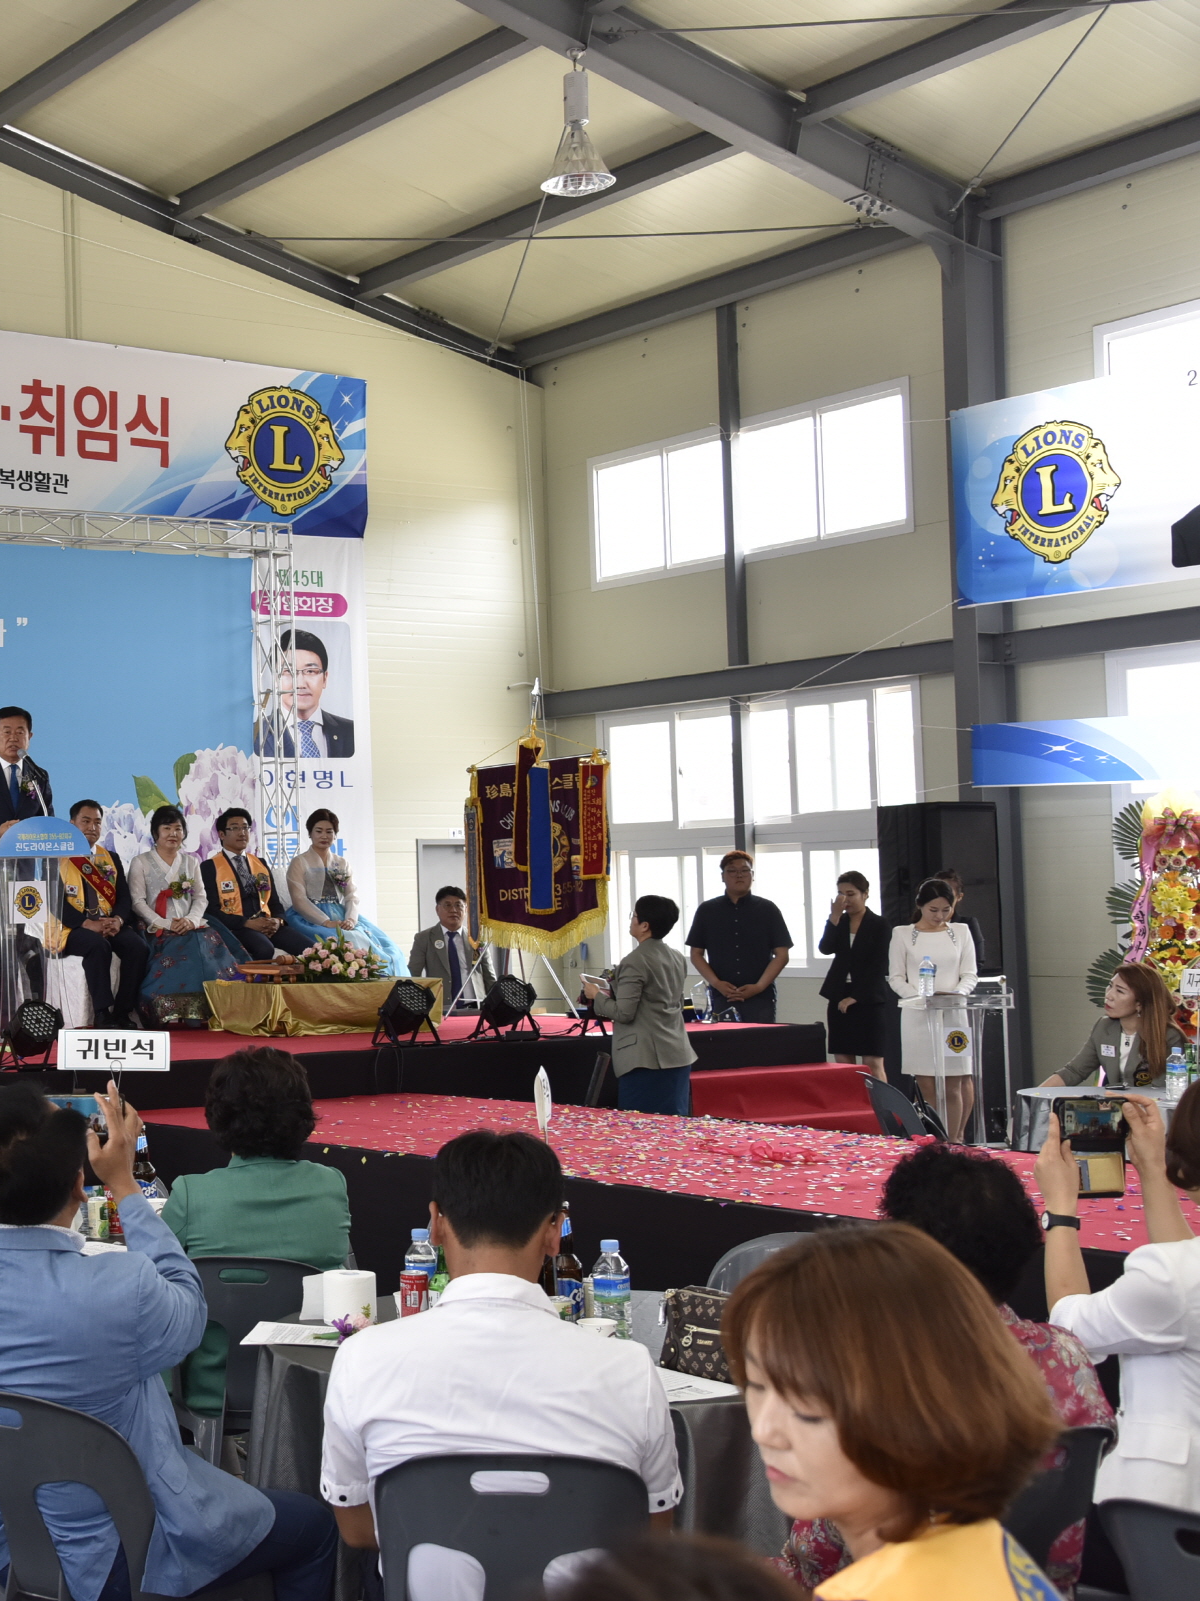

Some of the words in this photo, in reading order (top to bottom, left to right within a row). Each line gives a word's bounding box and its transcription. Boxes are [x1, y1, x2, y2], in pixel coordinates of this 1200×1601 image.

[256, 395, 315, 419] LIONS
[269, 425, 304, 473] L
[1020, 430, 1085, 459] LIONS
[249, 473, 321, 502] INTERNATIONAL
[1036, 464, 1075, 516] L
[1018, 514, 1095, 548] INTERNATIONAL
[15, 842, 74, 851] 진도라이온스클럽
[76, 1038, 154, 1060] 귀빈석
